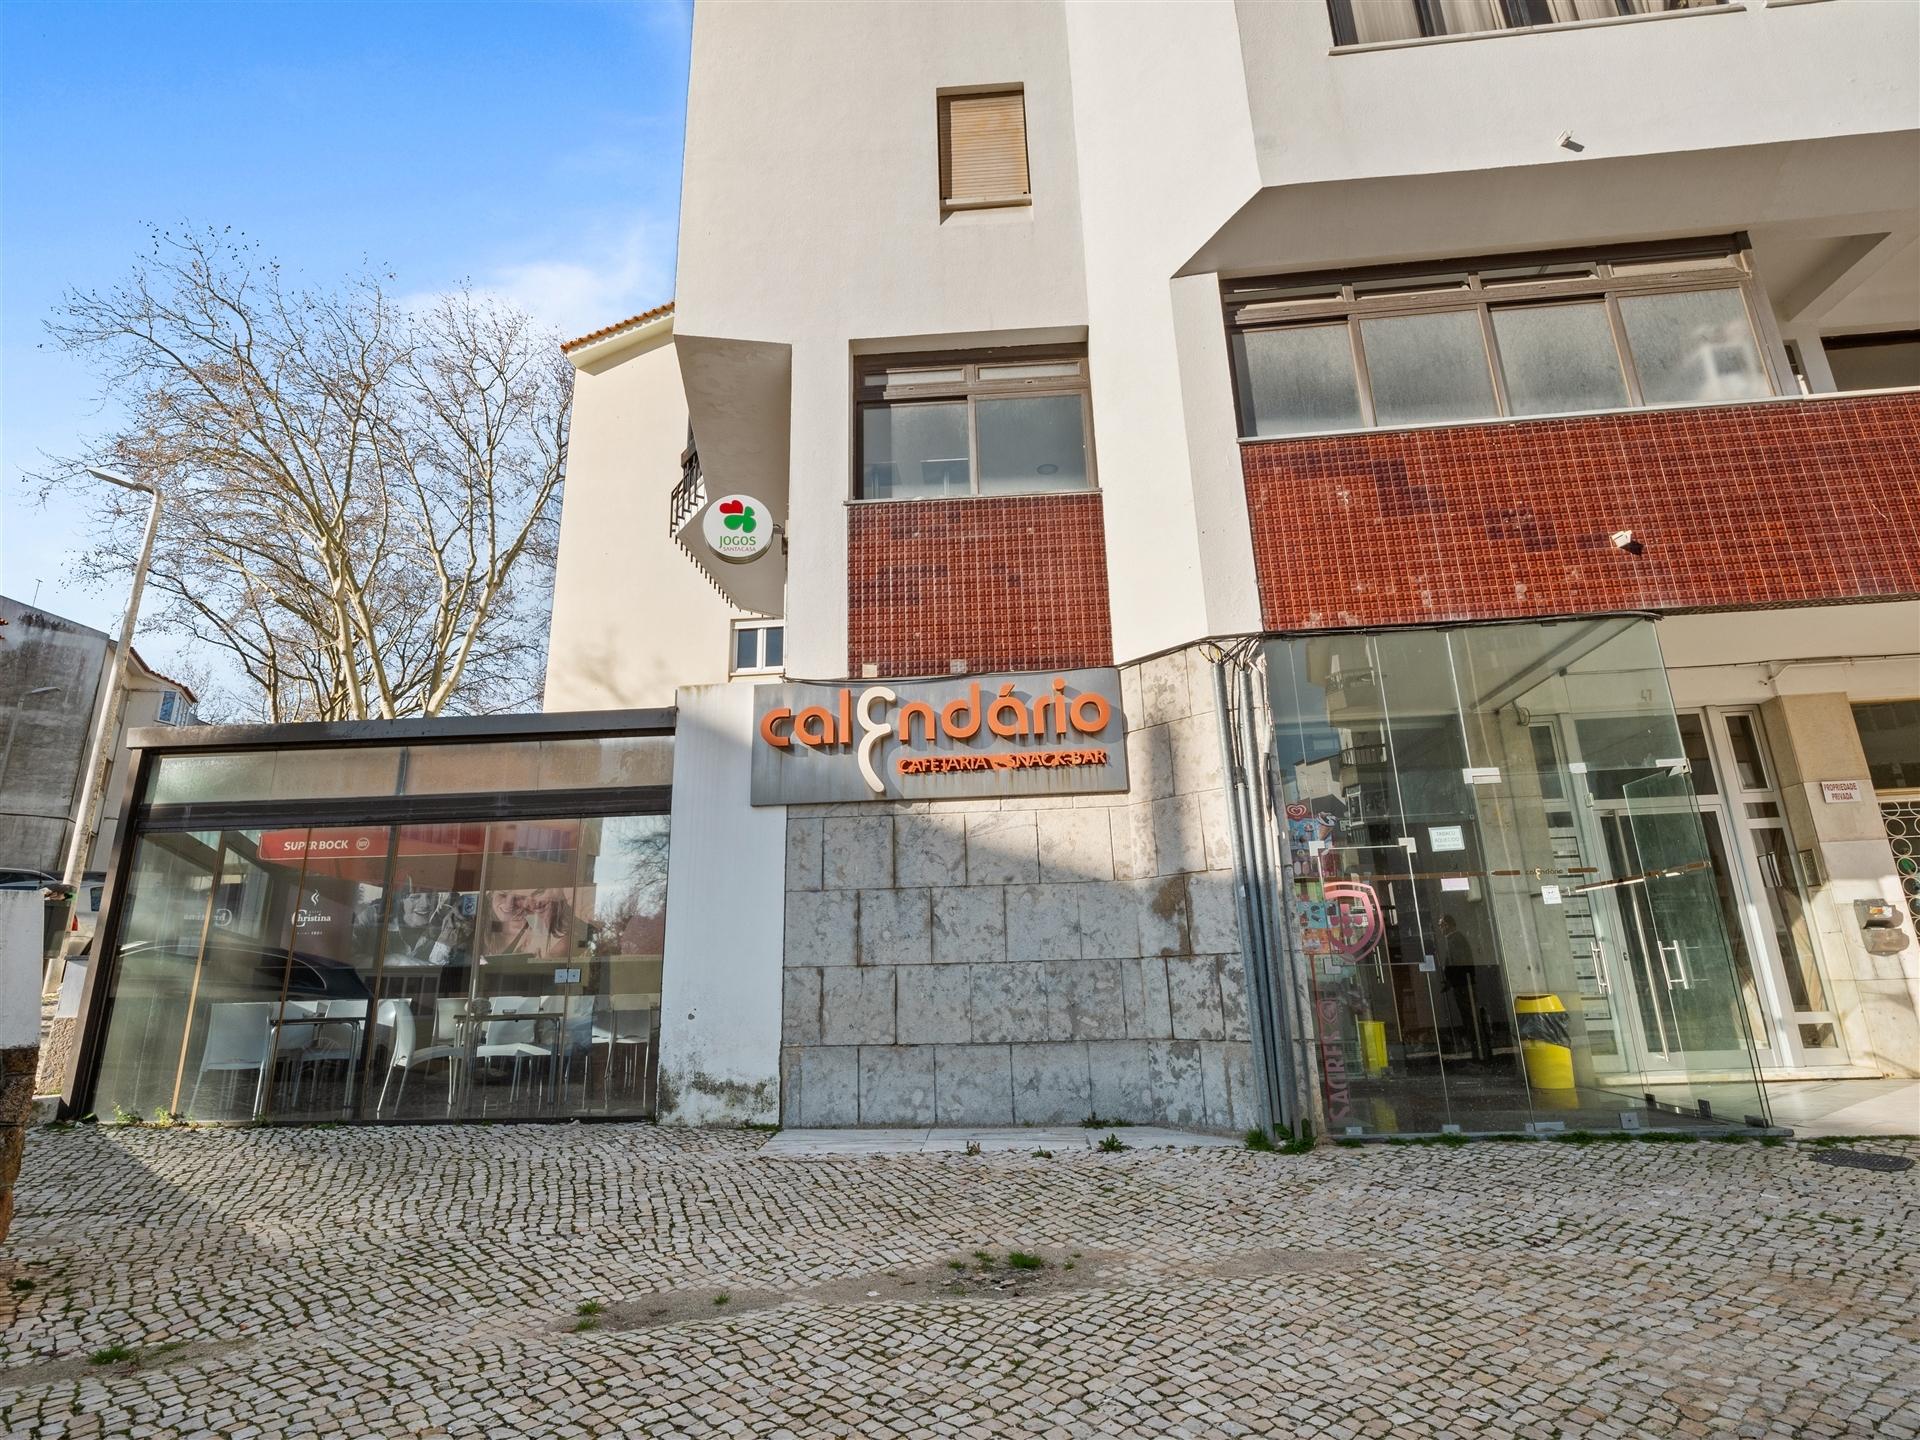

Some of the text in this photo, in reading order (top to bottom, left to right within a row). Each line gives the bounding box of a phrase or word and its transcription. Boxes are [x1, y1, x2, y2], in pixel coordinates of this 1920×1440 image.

[719, 535, 756, 548] JOGOS
[1831, 792, 1855, 801] PRIVADA
[318, 839, 349, 850] BOCK
